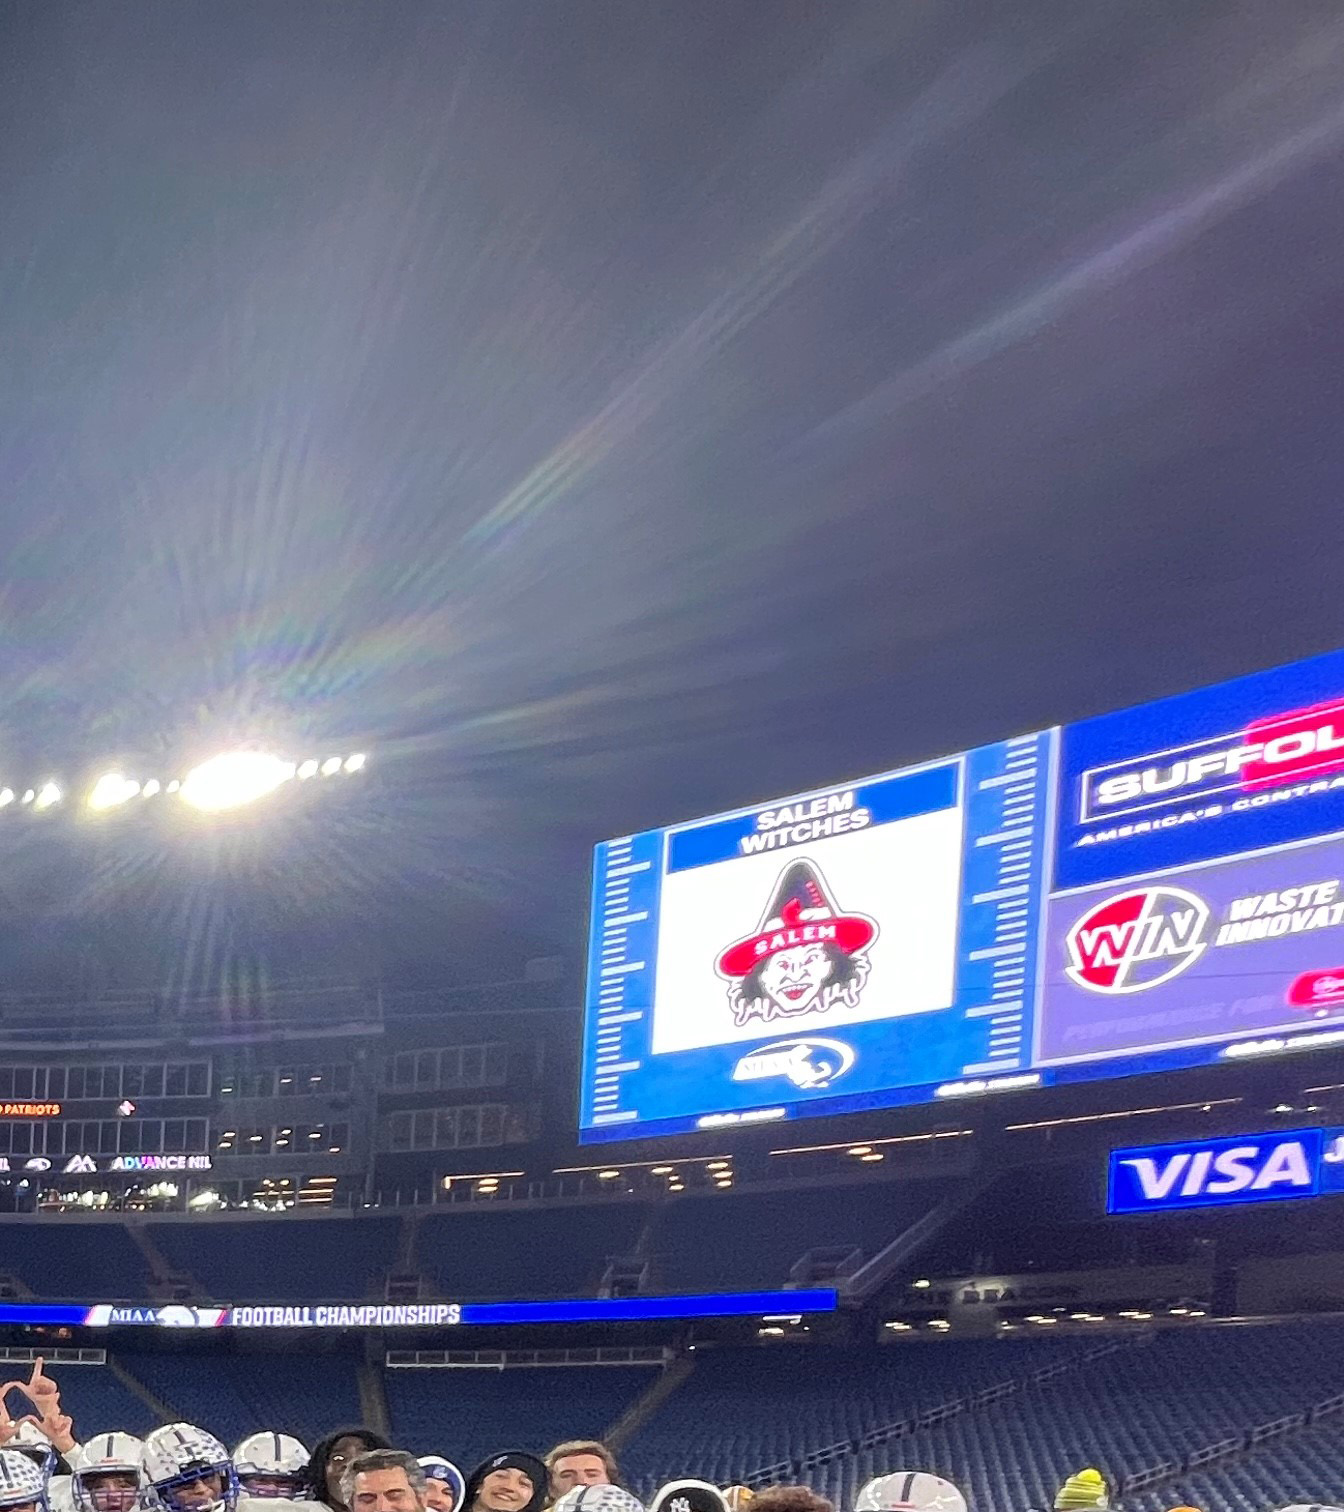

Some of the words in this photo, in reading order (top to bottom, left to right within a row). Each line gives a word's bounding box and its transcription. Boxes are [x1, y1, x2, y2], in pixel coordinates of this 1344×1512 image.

[757, 792, 853, 830] SALEM
[1076, 806, 1223, 847] AMERICA'S
[741, 809, 869, 853] WITCHES
[1230, 880, 1339, 921] WASTE
[755, 925, 836, 954] SALEM
[5, 1104, 60, 1115] PATRIOTS
[113, 1156, 185, 1170] ADVANCE
[188, 1155, 212, 1169] NIL
[1120, 1142, 1311, 1199] VISA
[112, 1308, 155, 1322] MIAA
[232, 1306, 312, 1326] FOOTBALL
[315, 1303, 460, 1326] CHAMPIONSHIPS
